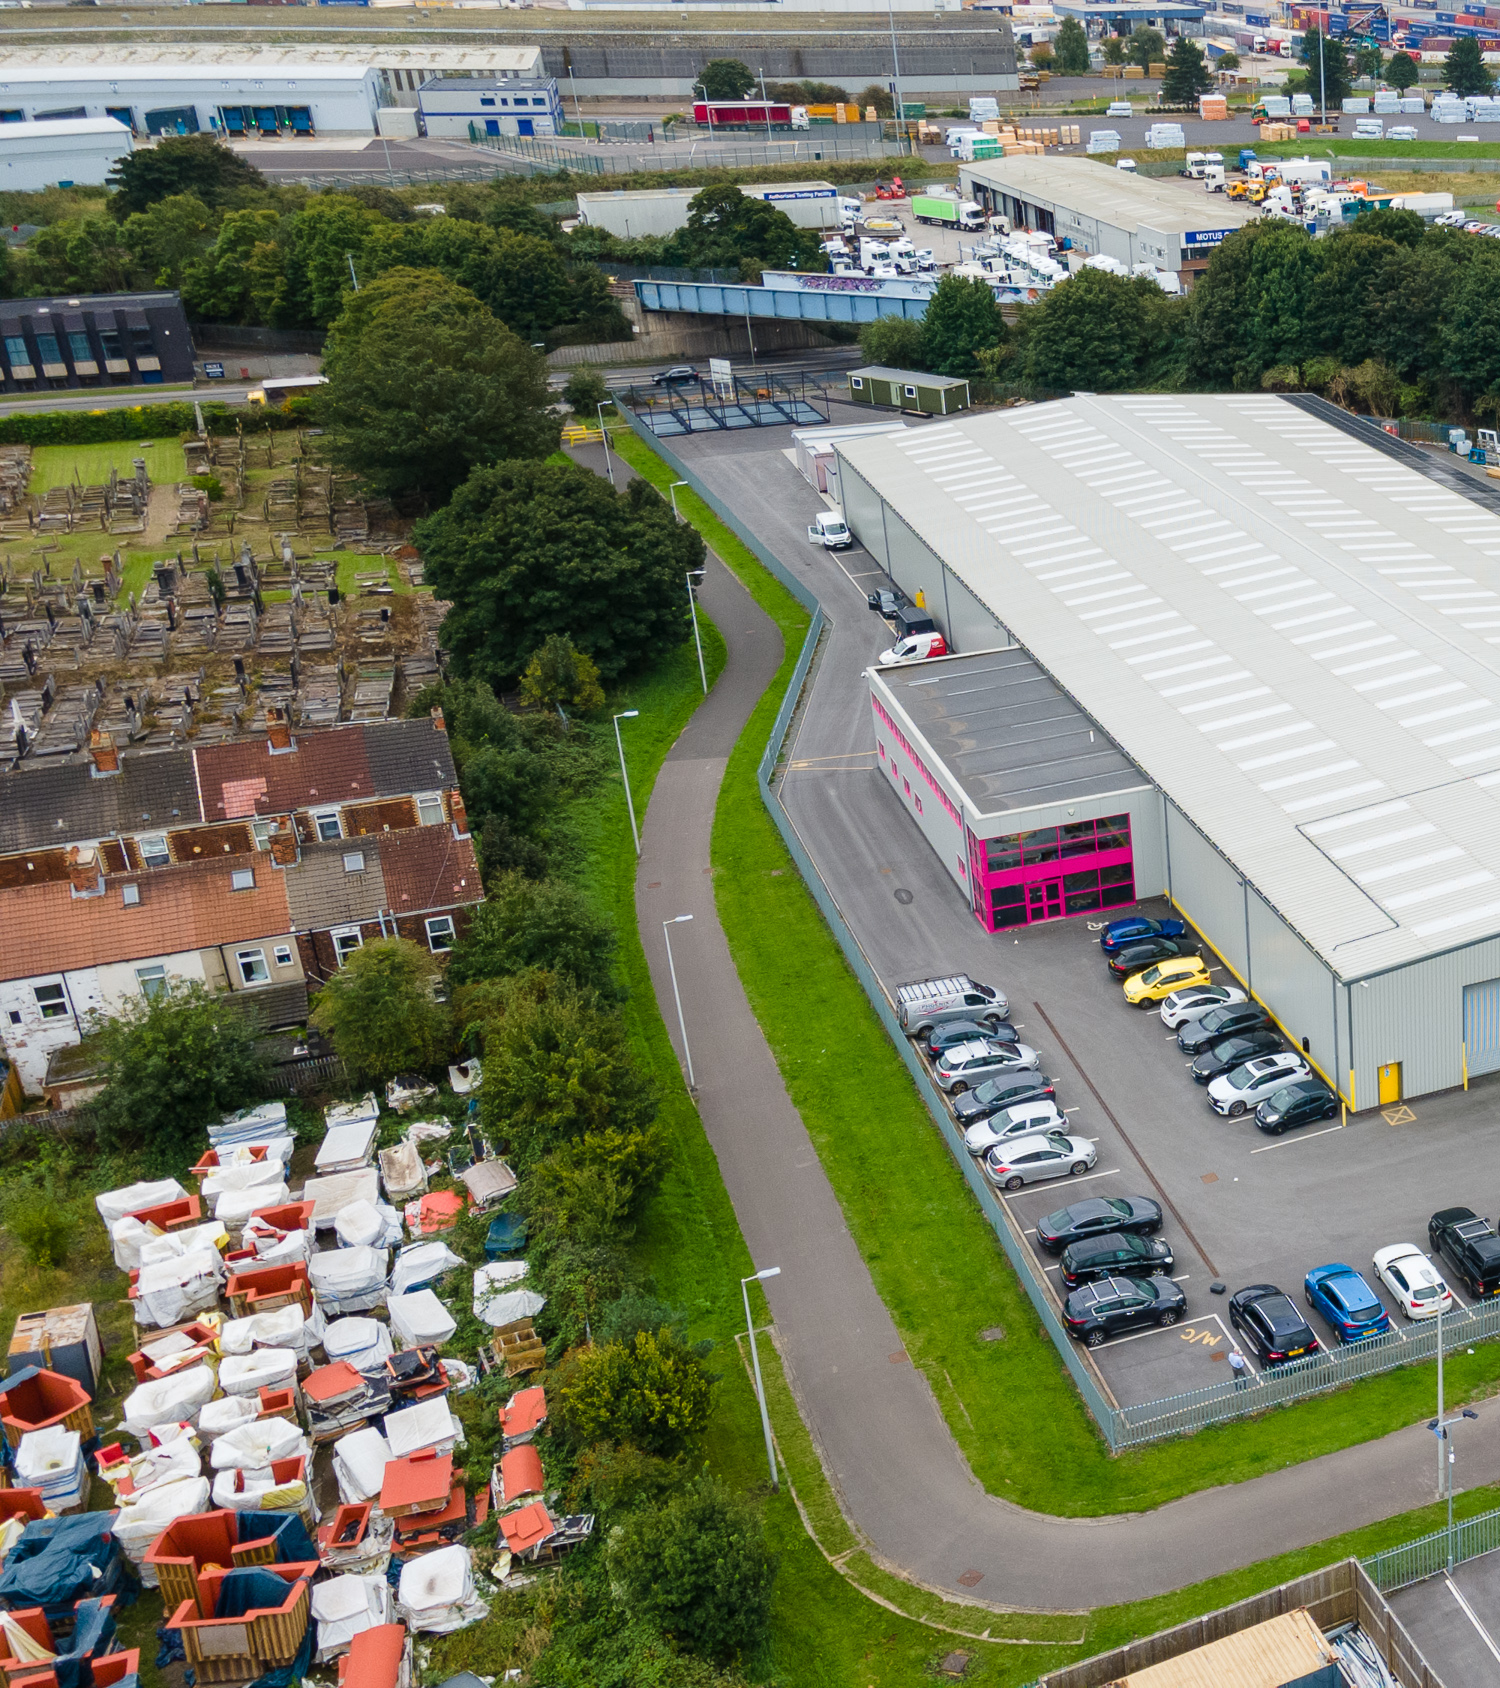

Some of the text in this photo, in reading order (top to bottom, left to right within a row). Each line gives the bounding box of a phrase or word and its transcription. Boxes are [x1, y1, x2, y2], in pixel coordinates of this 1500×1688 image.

[1196, 231, 1222, 241] MOTUS
[922, 1001, 949, 1009] PHOENIX
[1180, 1328, 1223, 1347] M/C
